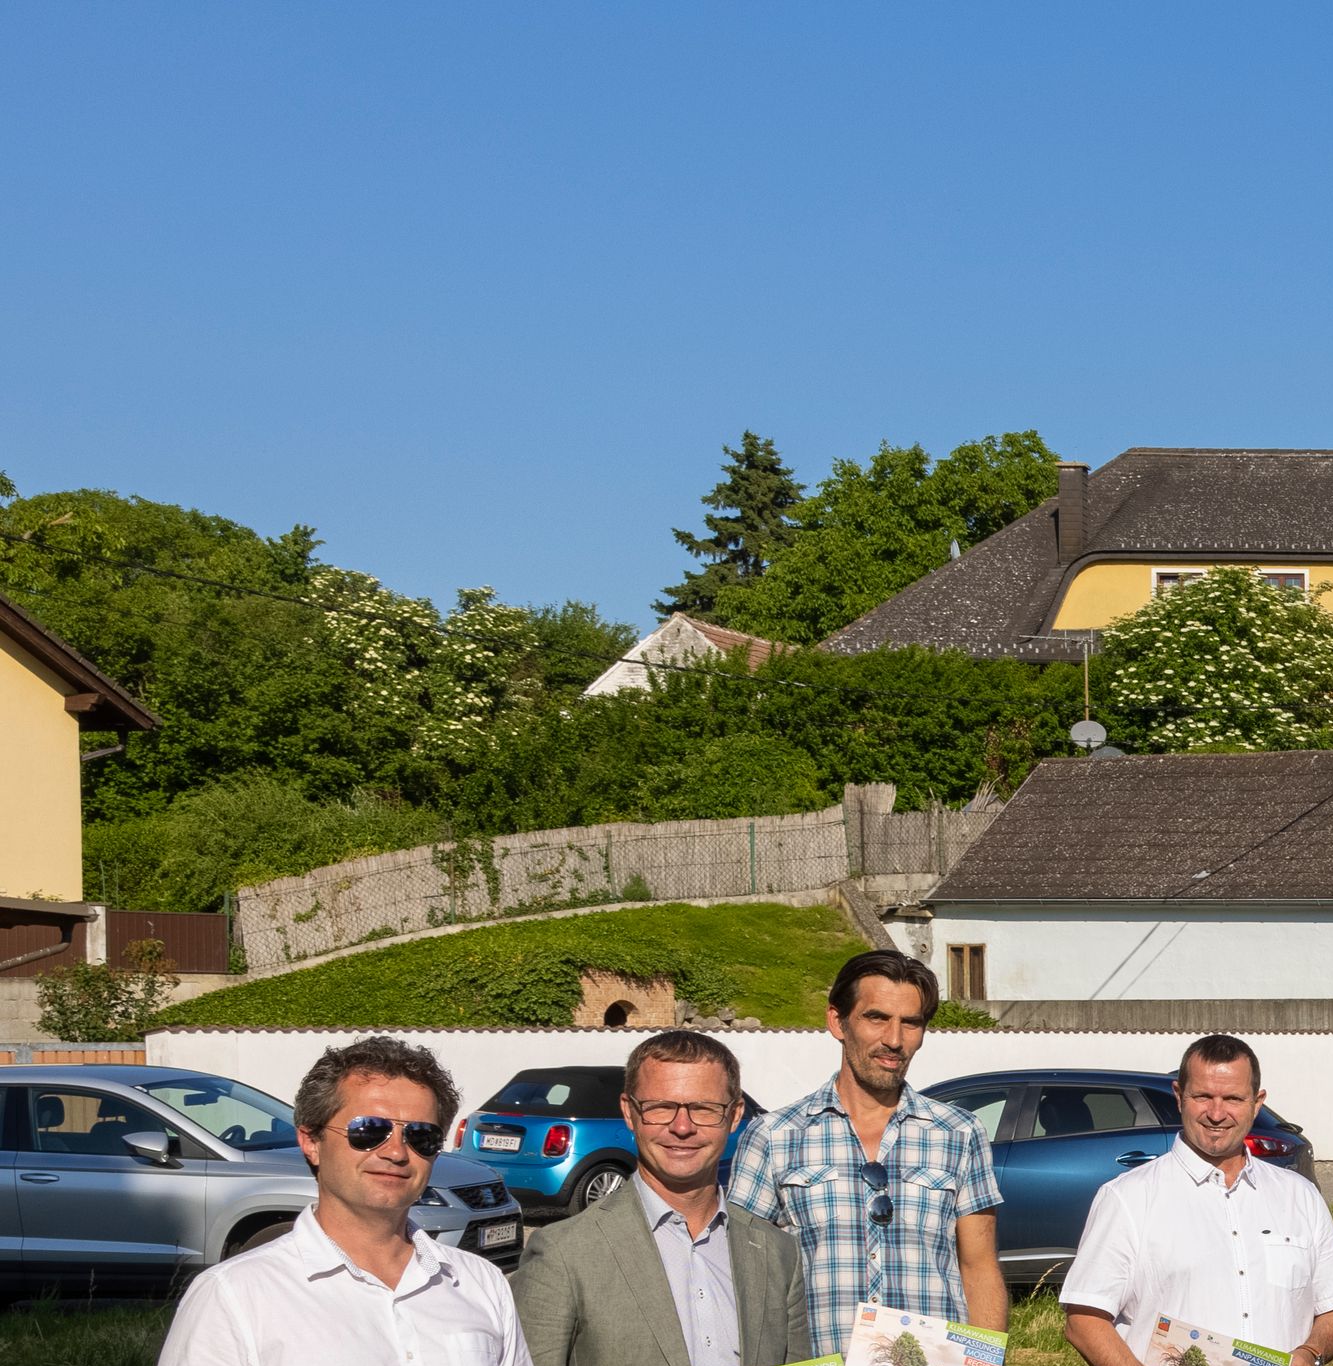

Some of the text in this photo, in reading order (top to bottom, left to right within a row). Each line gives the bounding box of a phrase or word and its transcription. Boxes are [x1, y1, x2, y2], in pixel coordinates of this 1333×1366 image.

[950, 1335, 1003, 1355] ANPASSUNGS-
[1235, 1341, 1288, 1366] KLIMAWANDEL-
[966, 1349, 1000, 1363] MODELL-
